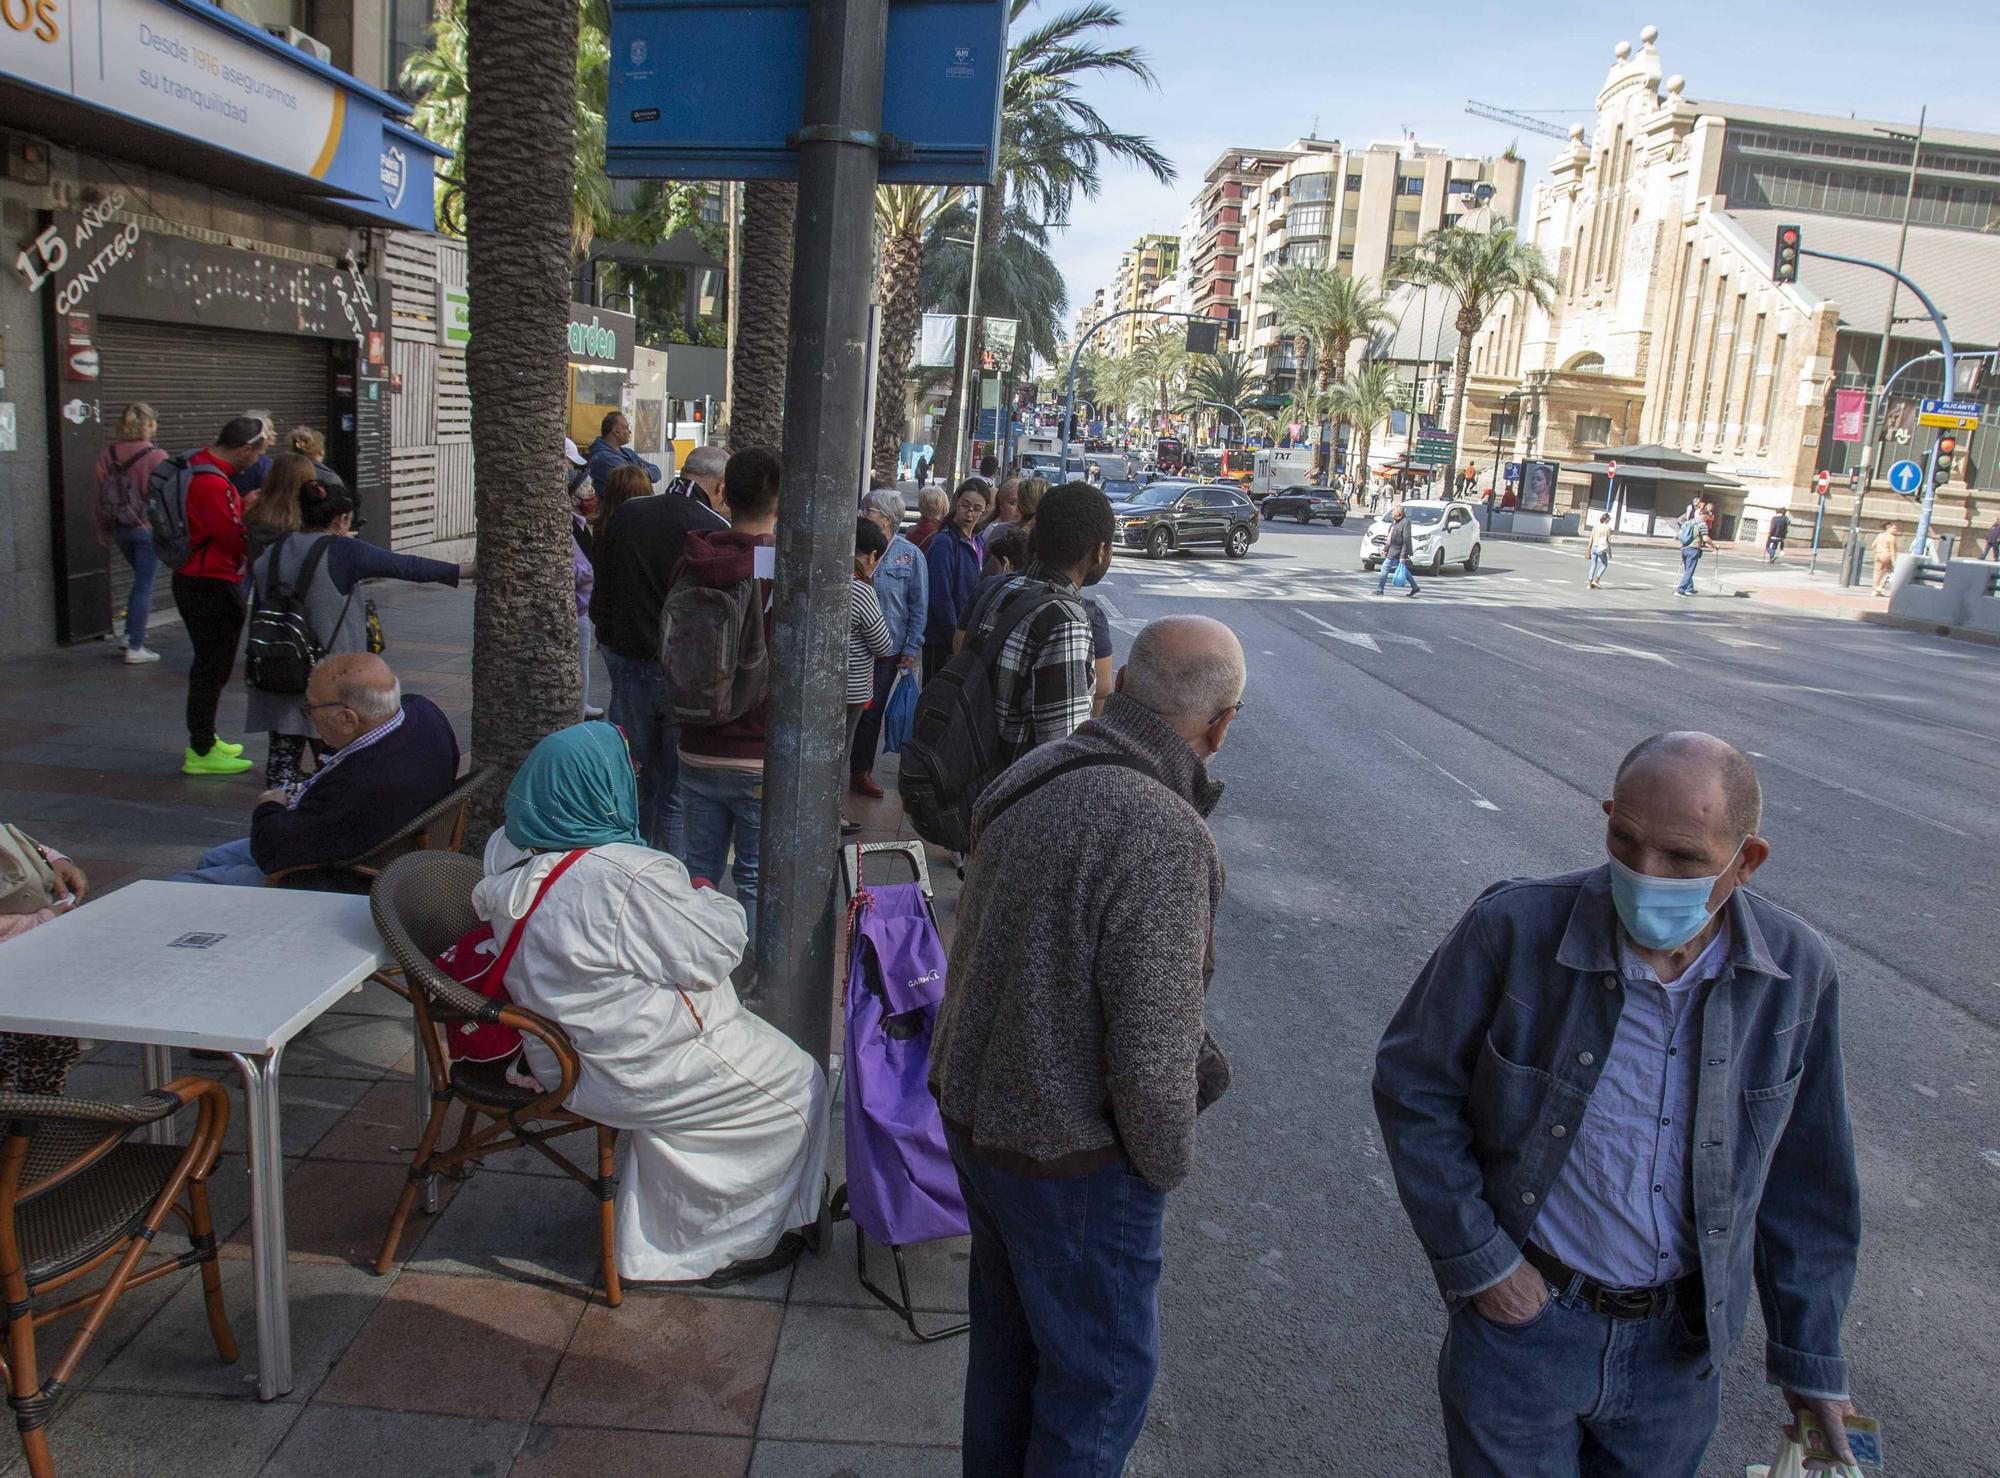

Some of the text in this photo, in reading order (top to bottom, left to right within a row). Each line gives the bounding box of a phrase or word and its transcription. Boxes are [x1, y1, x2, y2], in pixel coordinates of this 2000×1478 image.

[139, 23, 298, 110] Desde 1916 aseguramos
[139, 69, 248, 123] su tranquilidad
[16, 191, 125, 292] 15 AÑOS
[56, 222, 139, 315] CONTIGO
[566, 315, 616, 360] arden
[1942, 403, 1976, 411] ALICANTE
[1275, 452, 1292, 460] TXT
